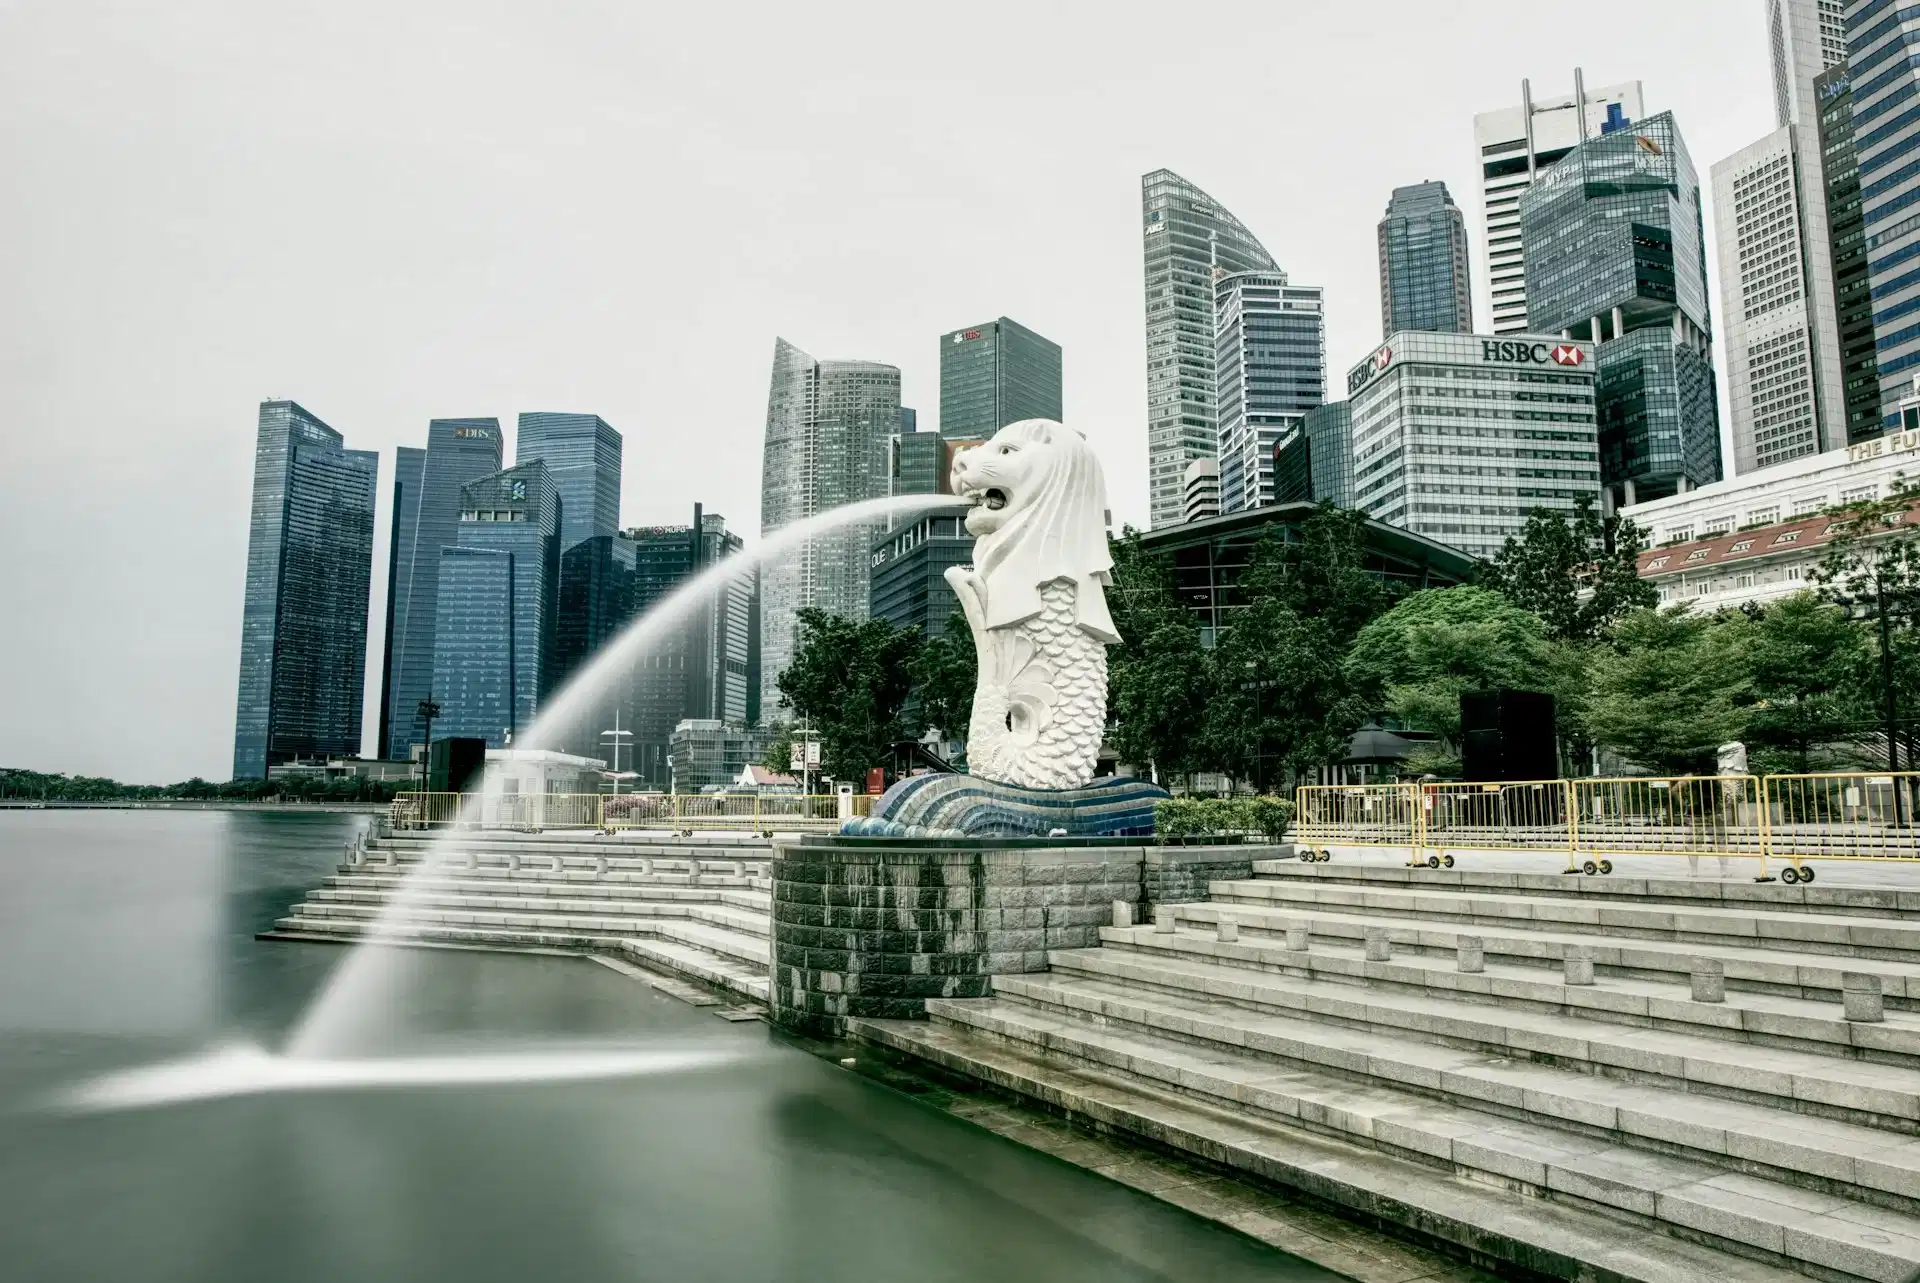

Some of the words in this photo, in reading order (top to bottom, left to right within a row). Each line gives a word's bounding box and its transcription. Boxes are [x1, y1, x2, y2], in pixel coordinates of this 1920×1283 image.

[1482, 340, 1549, 364] HSBC
[1348, 357, 1376, 394] HSBC
[465, 428, 489, 438] DBS
[1844, 440, 1883, 461] THE
[664, 525, 687, 534] MUFG
[871, 548, 887, 568] OUE
